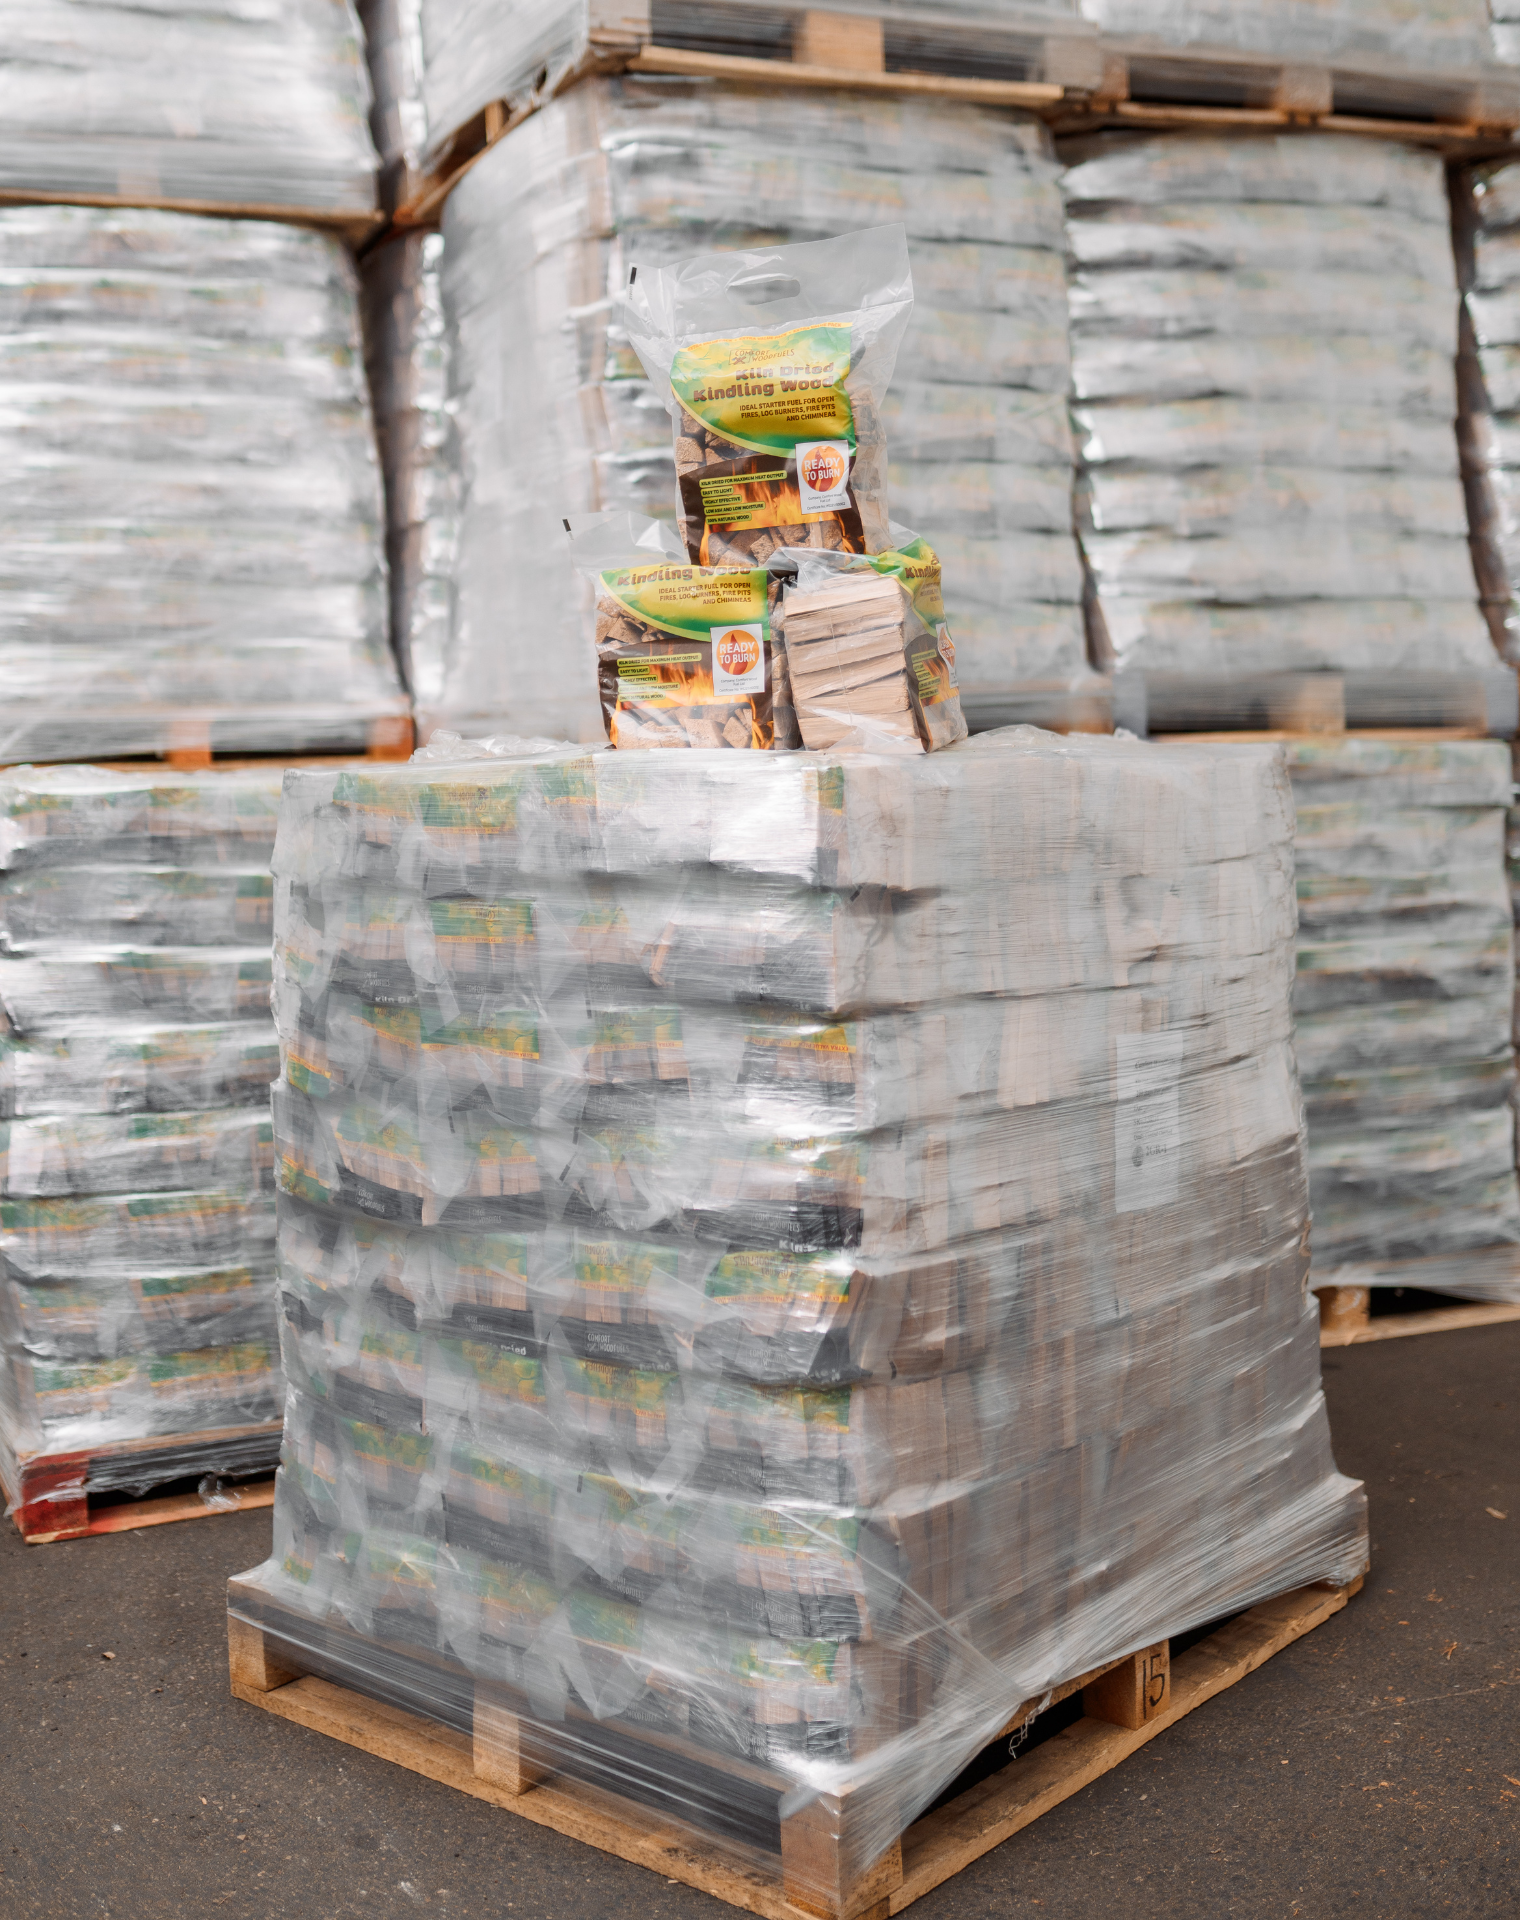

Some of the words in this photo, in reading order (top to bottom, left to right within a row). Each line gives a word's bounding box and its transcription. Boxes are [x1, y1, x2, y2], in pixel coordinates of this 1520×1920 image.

[752, 349, 795, 362] WOODFUELS
[735, 367, 774, 380] Kiln
[779, 362, 834, 377] Dried
[693, 382, 775, 402] Kindling
[780, 376, 834, 392] Wood
[739, 404, 758, 412] IDEAL
[758, 401, 786, 410] STARTER
[787, 399, 803, 408] FUEL
[803, 398, 817, 406] FOR
[817, 396, 835, 404] OPEN
[740, 410, 761, 419] FIRES,
[774, 406, 805, 416] BURNERS,
[786, 414, 800, 422] AND
[800, 411, 837, 421] CHIMINEAS
[804, 456, 841, 470] READY
[804, 471, 817, 481] TO
[818, 468, 840, 480] BURN
[617, 566, 693, 586] Kindling
[677, 584, 704, 594] STARTER
[704, 583, 719, 591] FUEL
[720, 582, 733, 590] FOR
[660, 594, 678, 602] FIRES,
[678, 593, 692, 601] LOG
[720, 641, 756, 654] READY
[719, 654, 731, 664] TO
[732, 652, 756, 664] BURN
[830, 1044, 849, 1052] EXTRA
[588, 1333, 610, 1344] COMFORT
[600, 1343, 630, 1353] WOODFUELS
[1142, 1653, 1165, 1720] 15
